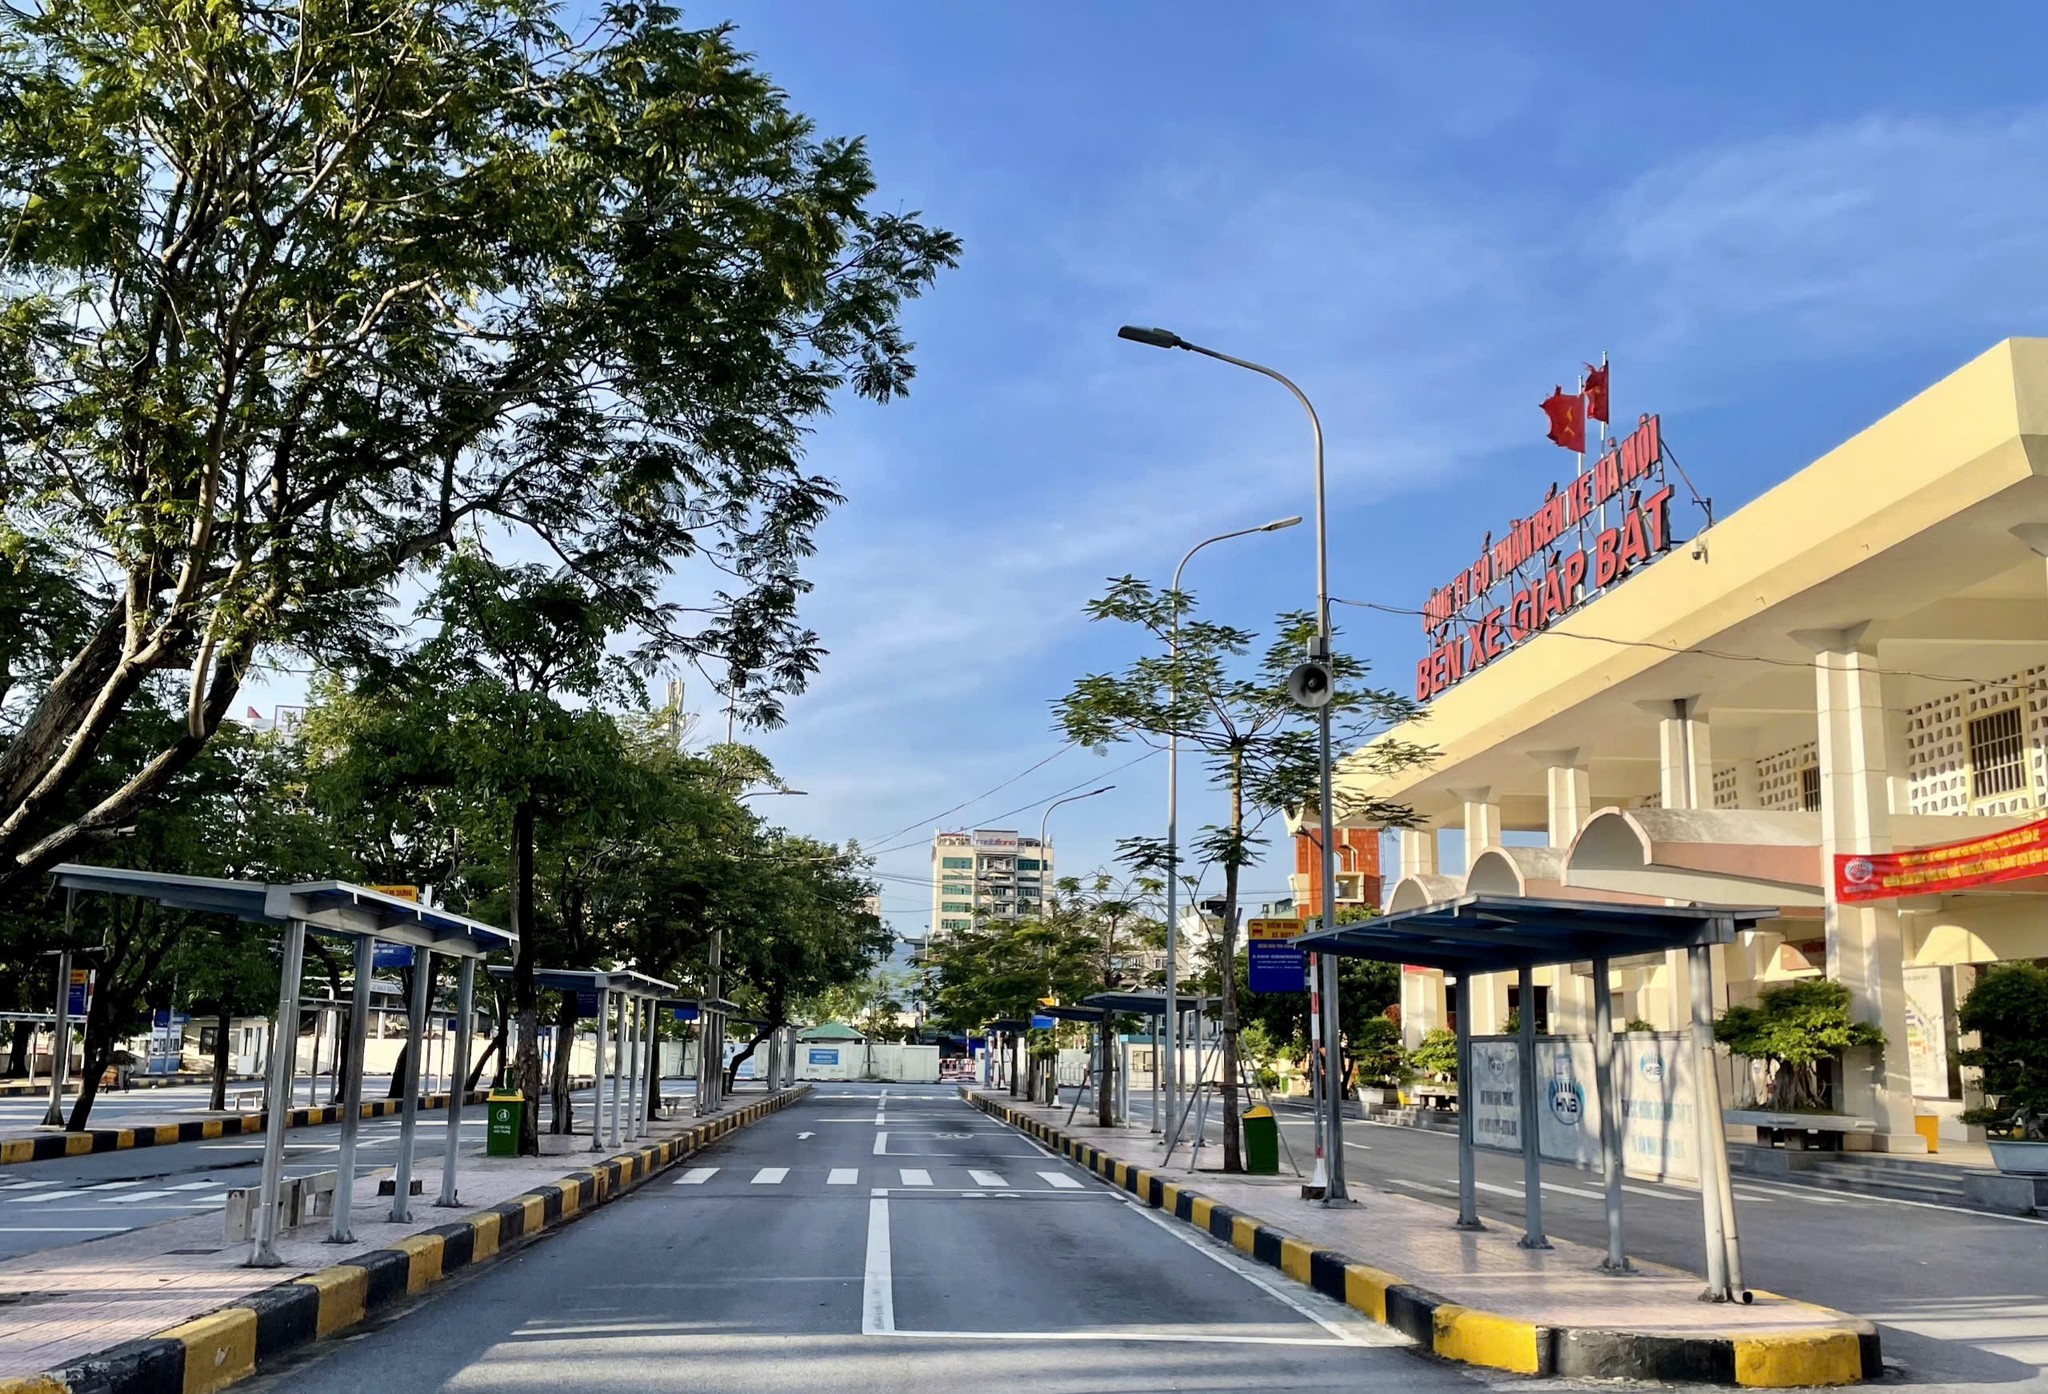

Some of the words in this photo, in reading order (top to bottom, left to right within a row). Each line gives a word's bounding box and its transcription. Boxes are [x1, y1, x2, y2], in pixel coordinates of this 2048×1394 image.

[1417, 623, 1463, 701] BẾN
[1468, 605, 1504, 672] XE
[1510, 549, 1587, 642] GIÁP
[1596, 484, 1674, 588] BÁT
[1423, 587, 1453, 635] CÔNG
[1454, 568, 1470, 611] TY
[1473, 531, 1492, 595] CỔ
[1494, 516, 1534, 581] PHẦN
[1533, 482, 1565, 551] BẾN
[1567, 470, 1592, 526] XE
[1594, 437, 1621, 505] HÀ
[1622, 413, 1660, 483] NỘI
[1556, 1096, 1577, 1113] HNB
